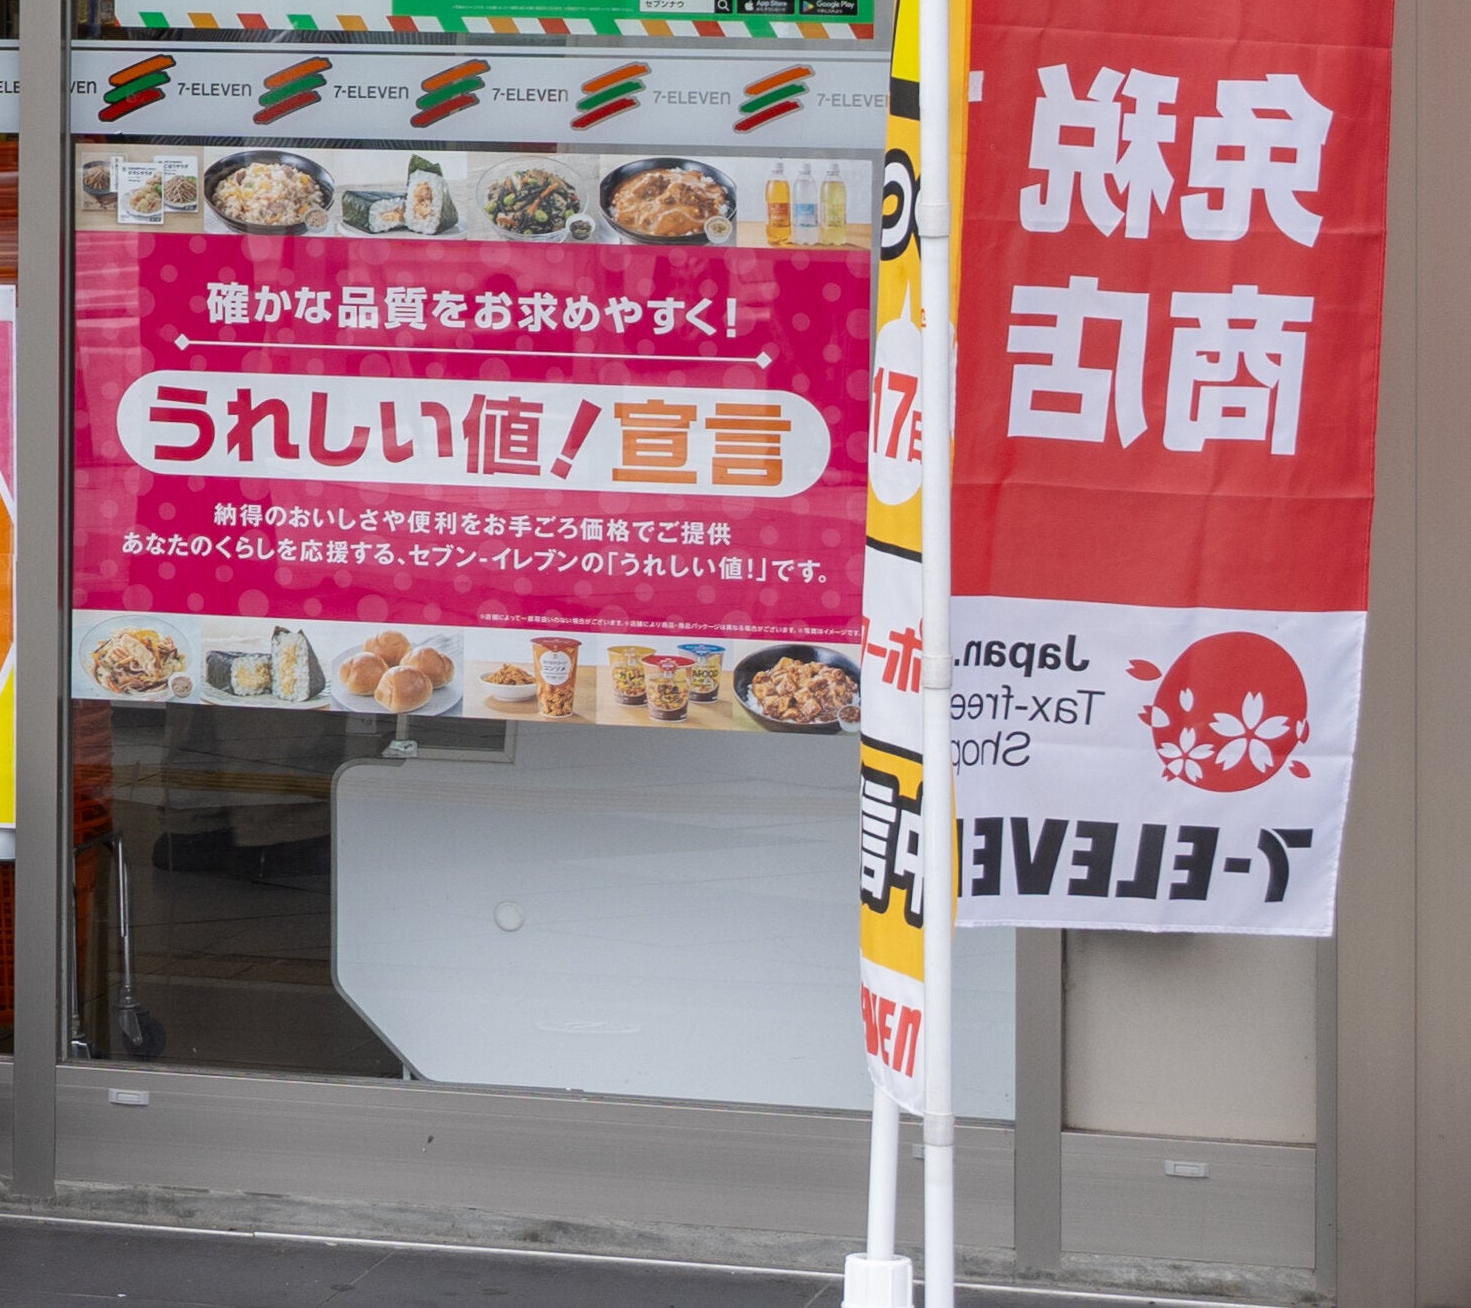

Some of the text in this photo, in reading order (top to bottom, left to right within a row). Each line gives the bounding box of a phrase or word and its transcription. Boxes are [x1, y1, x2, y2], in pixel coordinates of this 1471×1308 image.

[645, 0, 685, 9] セブンナウ
[756, 0, 788, 9] App Store
[816, 0, 855, 10] Google Play
[206, 282, 739, 339] 確かな品質をお求めやすく!
[213, 501, 733, 547] 納得のおいしさや便利をお手ごろ価格でご提供
